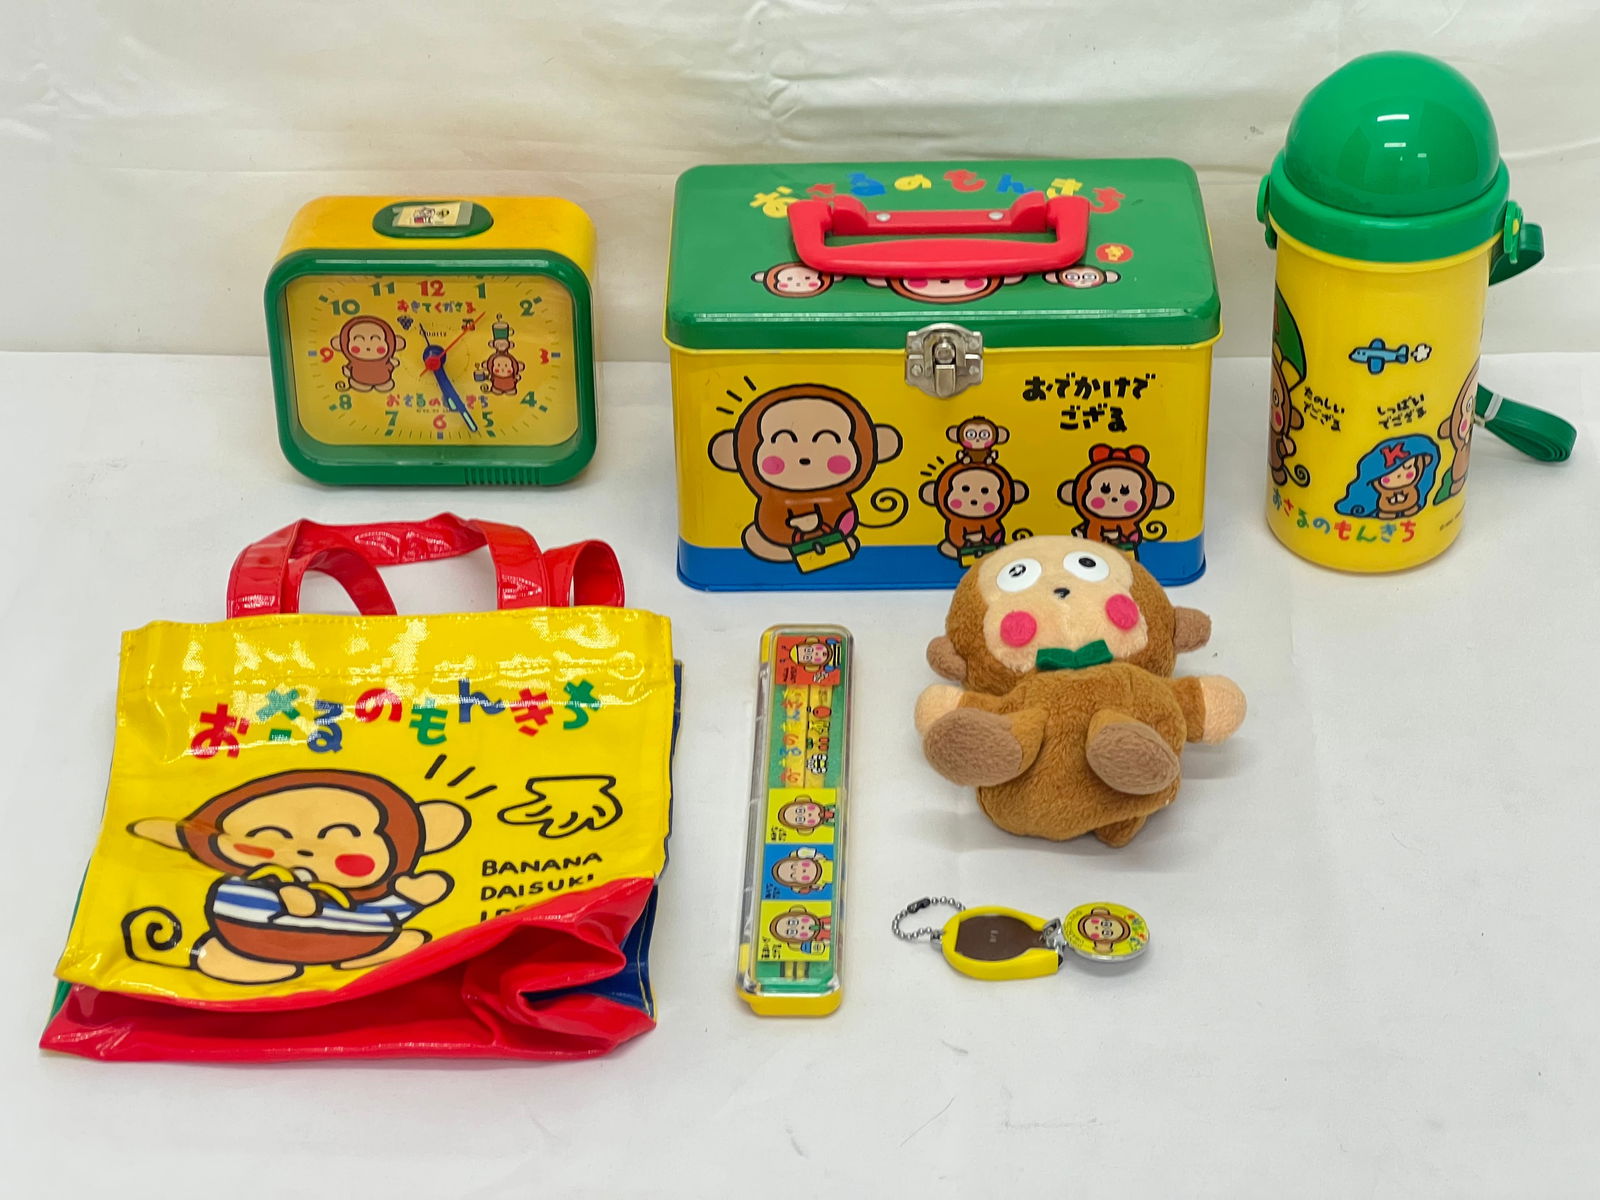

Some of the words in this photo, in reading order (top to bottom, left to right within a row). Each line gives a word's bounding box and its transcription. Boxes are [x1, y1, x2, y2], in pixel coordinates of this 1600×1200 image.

[371, 282, 396, 297] 11
[416, 280, 446, 297] 12
[475, 282, 487, 299] 1
[331, 299, 361, 315] 10
[519, 300, 536, 316] 2
[320, 347, 334, 364] 9
[539, 348, 550, 364] 3
[1022, 372, 1157, 401] おでかけで
[338, 394, 353, 410] 8
[520, 391, 537, 407] 4
[385, 410, 399, 427] 7
[433, 414, 447, 430] 6
[482, 411, 494, 427] 5
[1059, 402, 1128, 432] ござる
[1380, 442, 1411, 468] K
[190, 678, 601, 759] おさるのもんきち
[482, 852, 603, 877] BANANA
